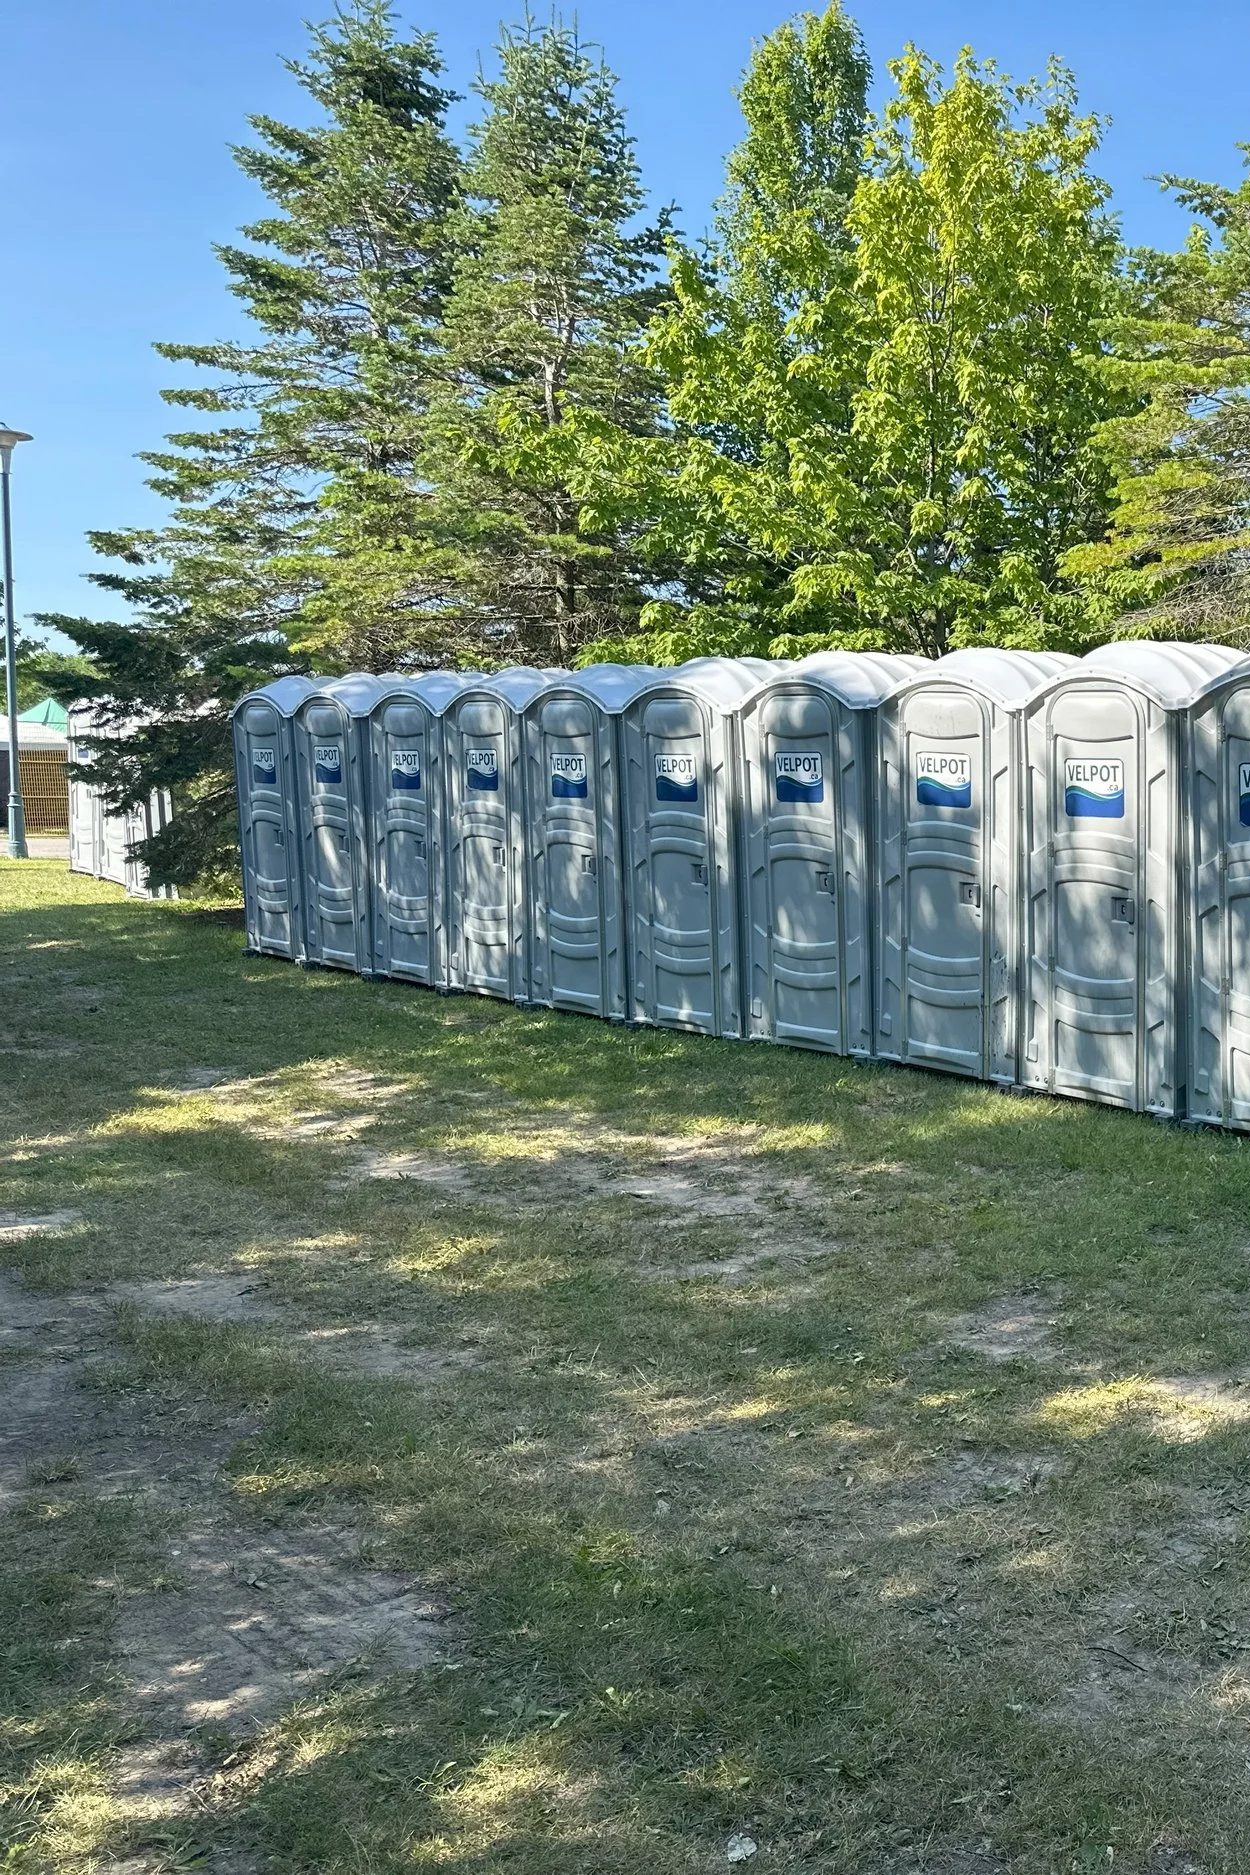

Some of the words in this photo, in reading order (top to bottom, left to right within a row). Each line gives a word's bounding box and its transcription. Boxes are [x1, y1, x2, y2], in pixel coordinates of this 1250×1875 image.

[552, 758, 583, 771] VELPOT
[657, 759, 692, 773] VELPOT
[777, 757, 819, 773] VELPOT
[919, 757, 967, 775] VELPOT
[1068, 764, 1120, 783] VELPOT
